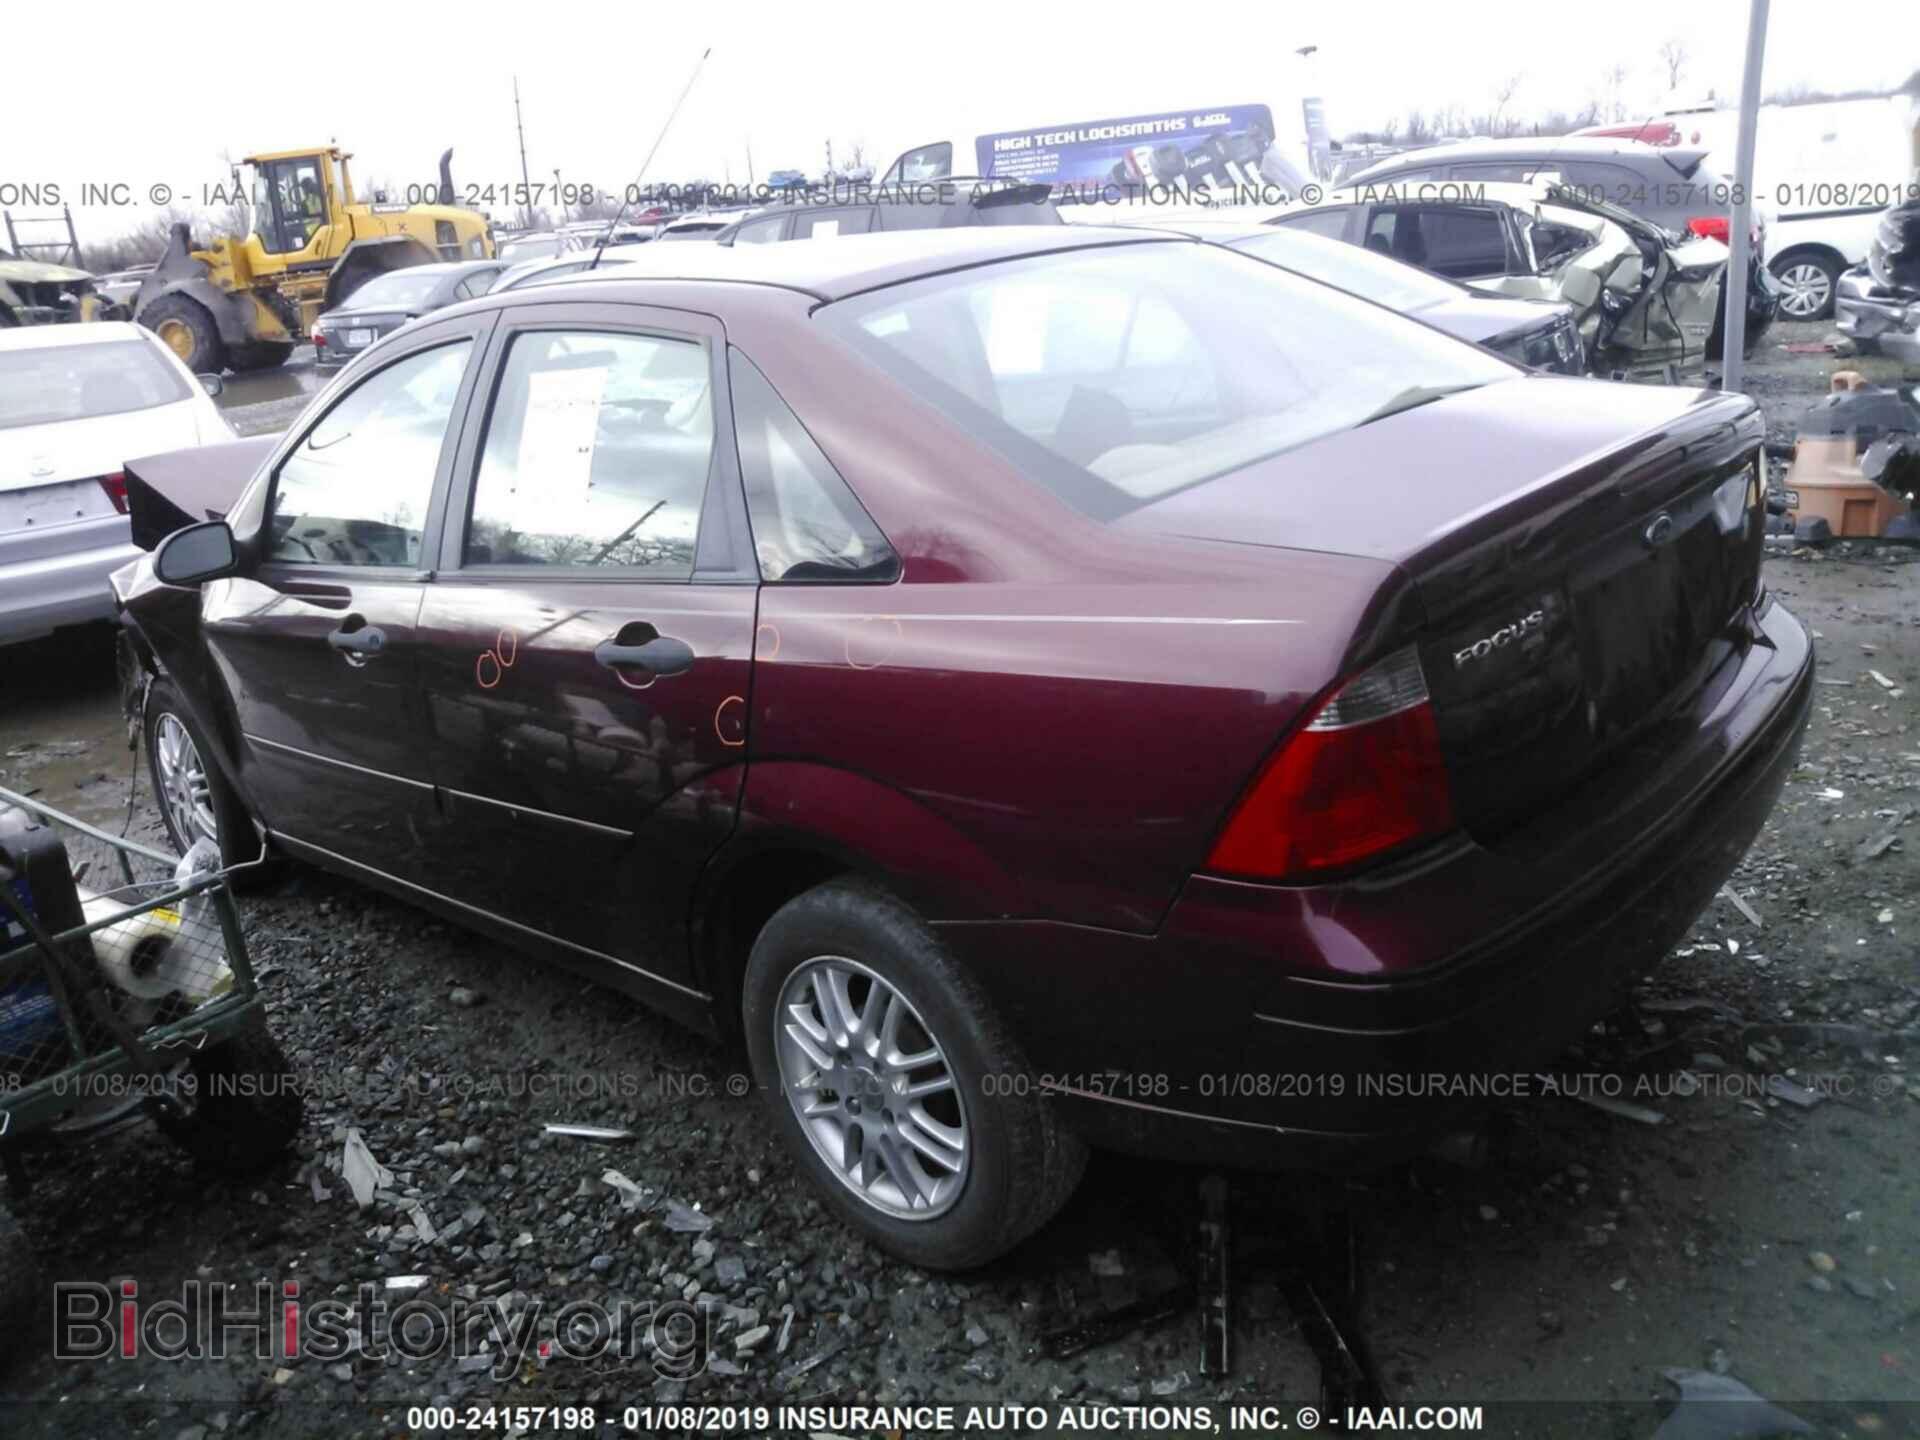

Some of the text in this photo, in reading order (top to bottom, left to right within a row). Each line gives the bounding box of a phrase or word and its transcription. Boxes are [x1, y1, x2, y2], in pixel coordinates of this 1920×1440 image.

[994, 136, 1031, 152] HIGH
[1034, 130, 1076, 147] TECH
[1453, 609, 1543, 667] FOCUS
